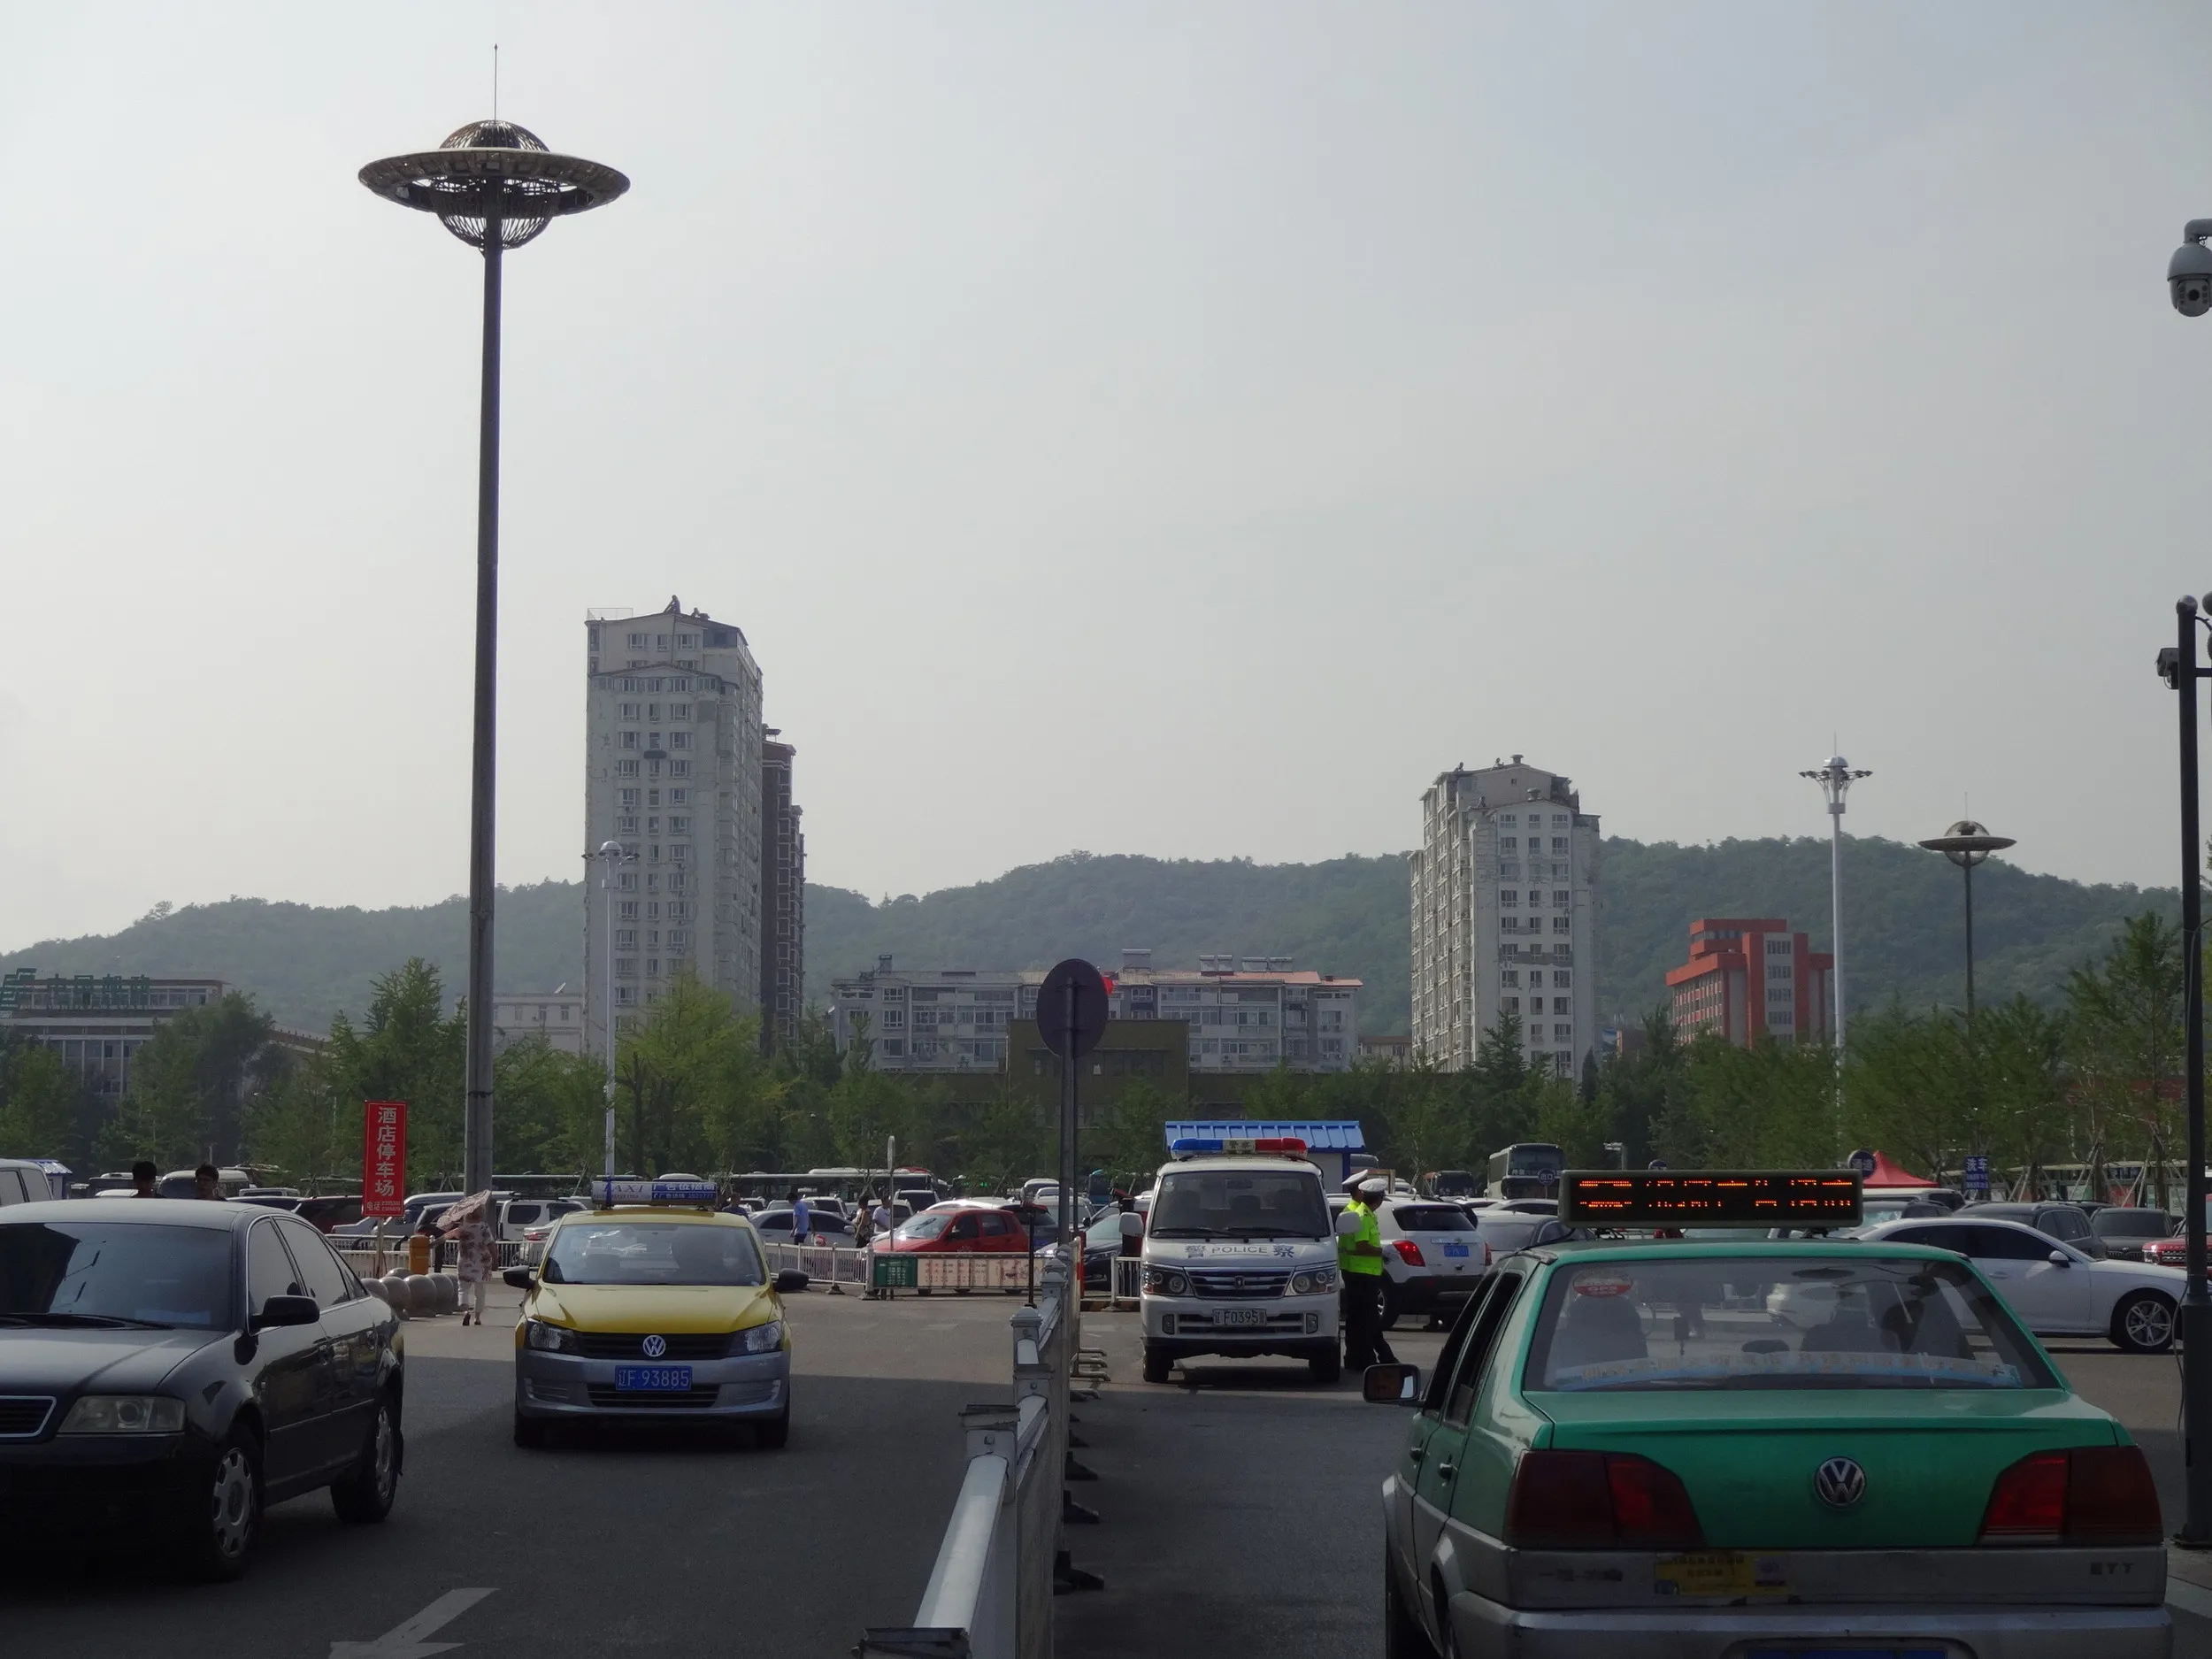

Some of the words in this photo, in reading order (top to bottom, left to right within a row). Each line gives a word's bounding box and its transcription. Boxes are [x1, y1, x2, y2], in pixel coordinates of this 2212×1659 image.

[375, 1107, 396, 1196] 酒店停车场
[1966, 1157, 1988, 1171] 洗车
[1272, 1245, 1294, 1257] 察
